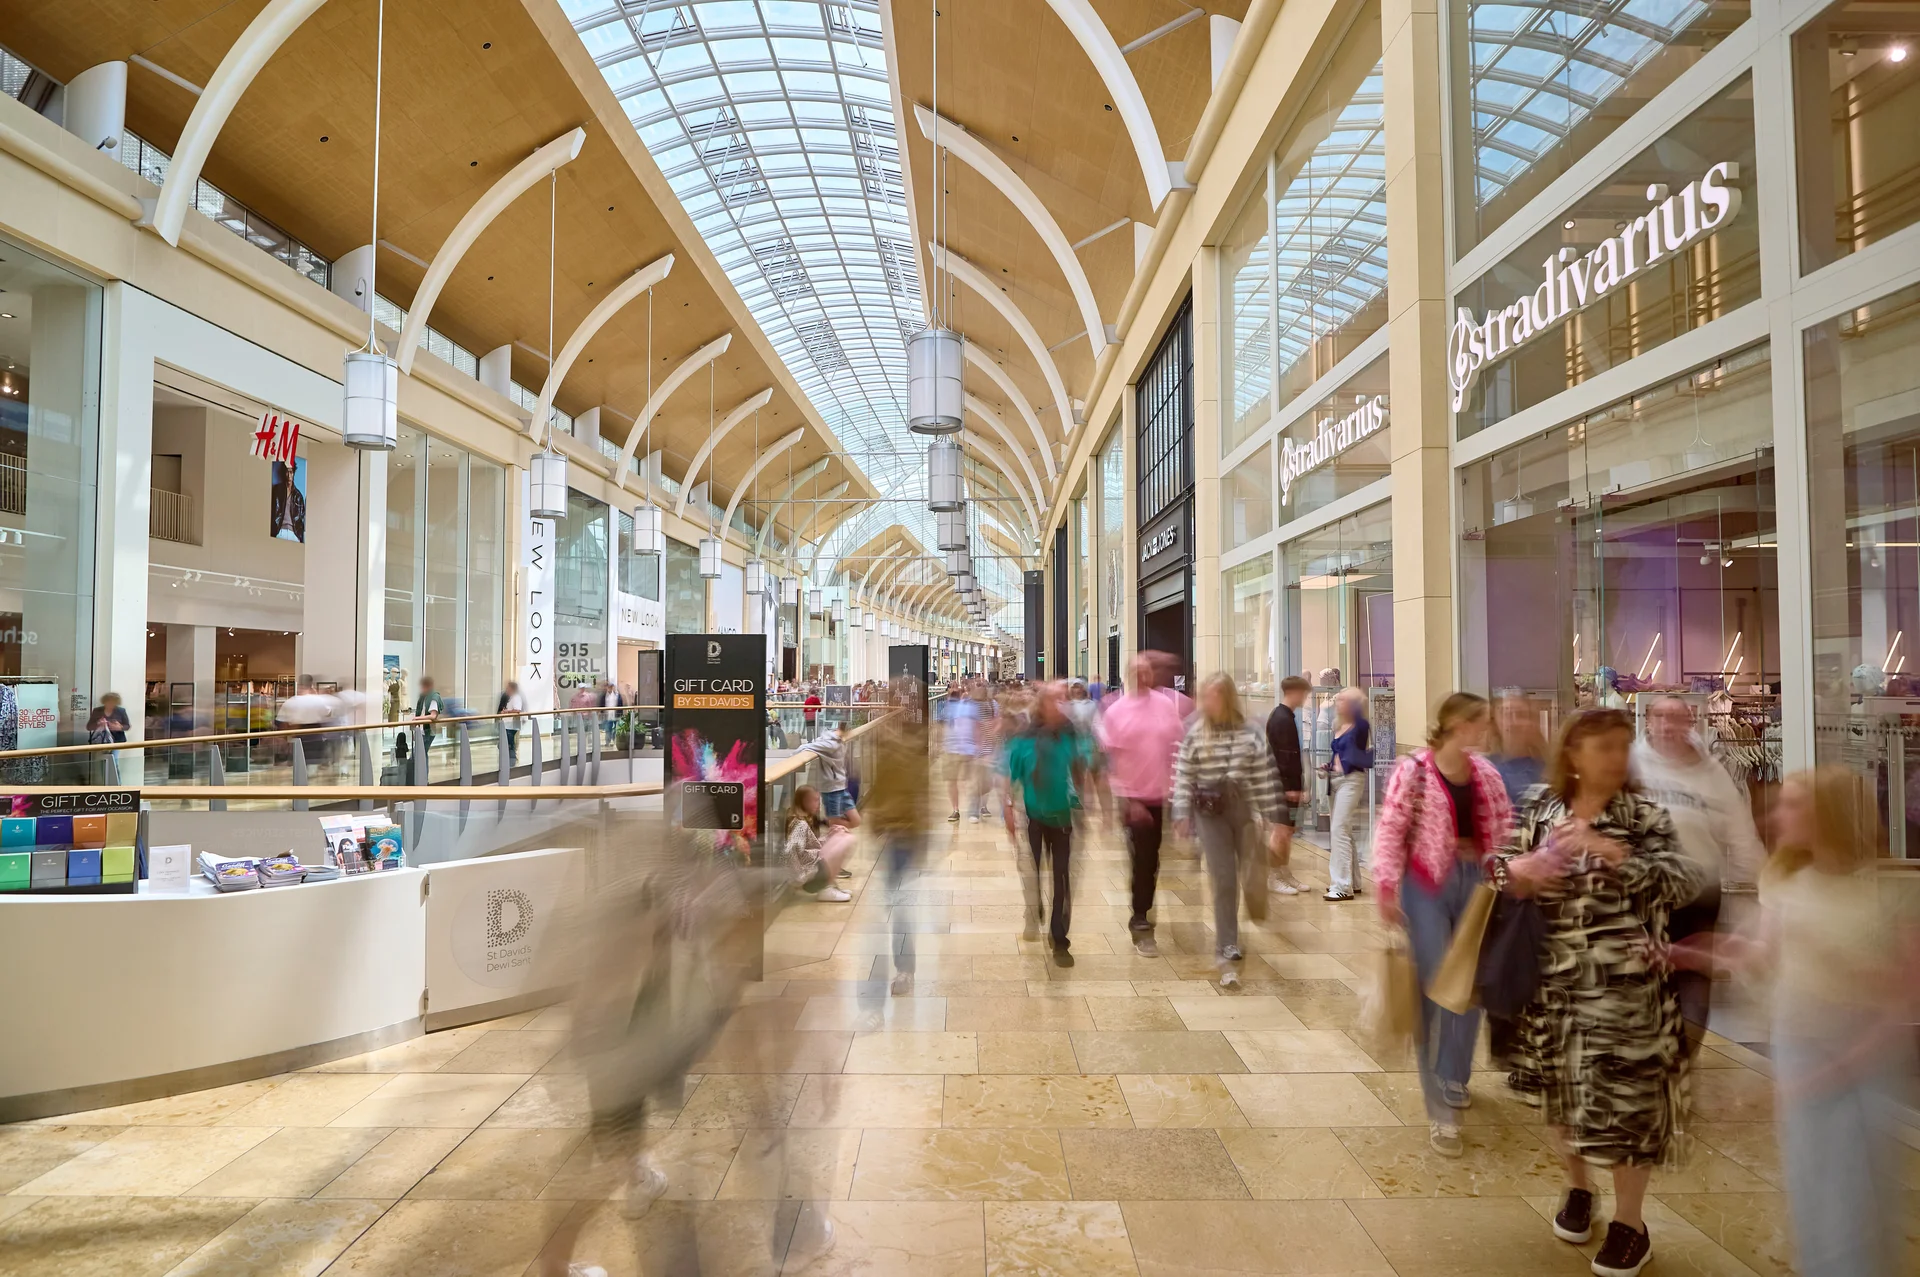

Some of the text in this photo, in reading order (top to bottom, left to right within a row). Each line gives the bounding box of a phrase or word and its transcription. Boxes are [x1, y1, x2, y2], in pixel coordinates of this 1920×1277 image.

[255, 413, 300, 468] H&M
[530, 521, 544, 680] EW LOOK
[621, 608, 660, 628] NEW LOOK
[559, 643, 588, 657] 915
[557, 659, 600, 673] GIRL
[674, 679, 754, 692] GIFT CARD
[678, 697, 749, 707] BY ST DAVID'S
[36, 708, 50, 716] OFF
[18, 721, 46, 729] STYLES
[685, 785, 738, 794] GIFT CARD
[41, 793, 132, 808] GIFT CARD
[486, 945, 532, 961] St David's
[486, 957, 532, 973] Dewi Sant
